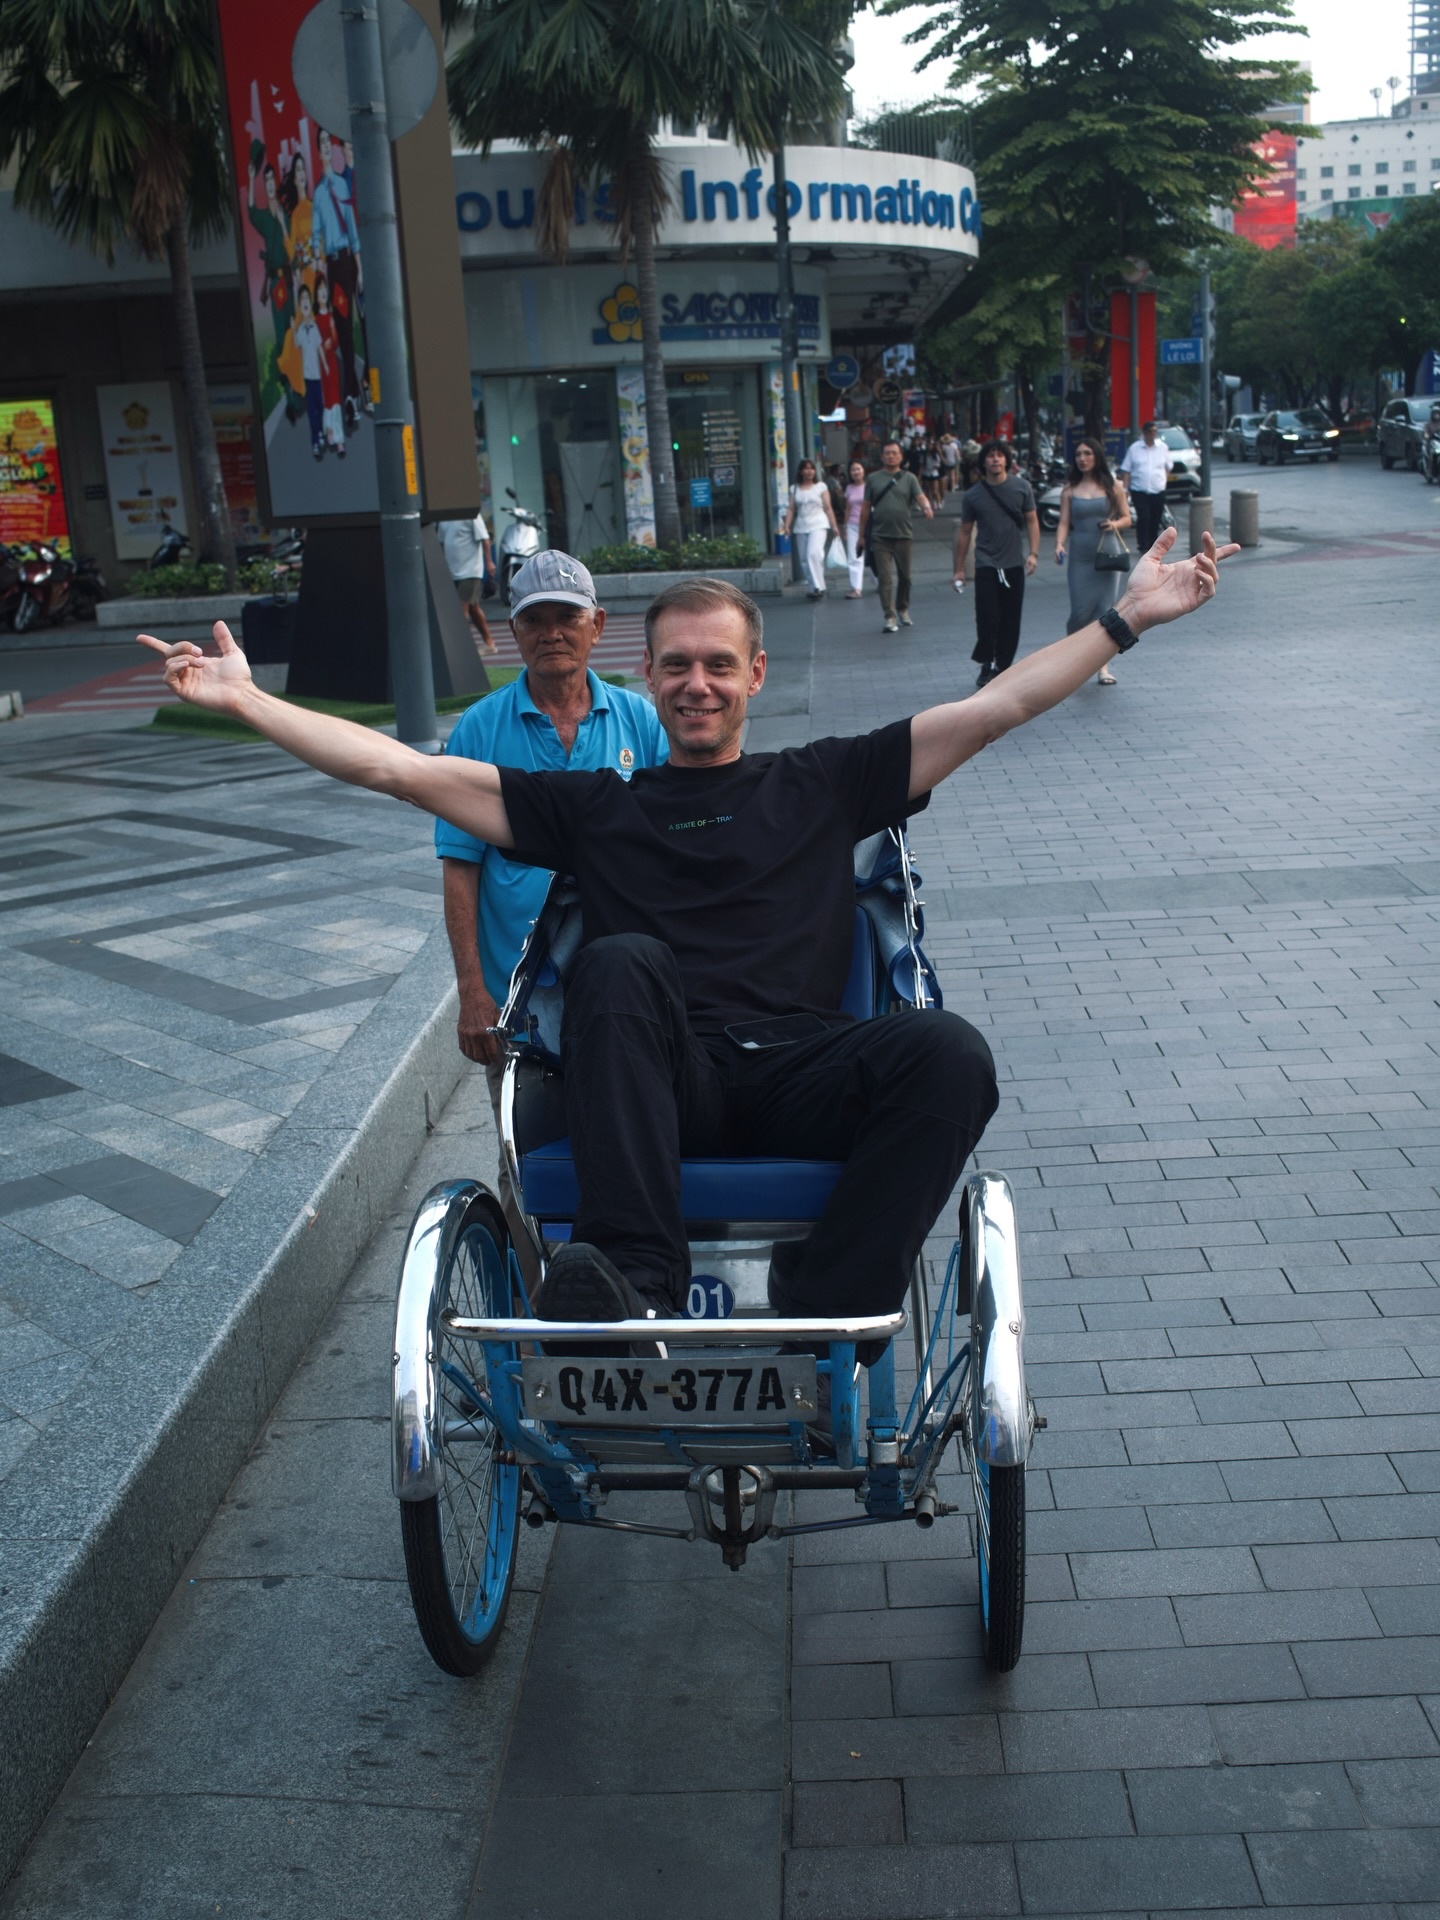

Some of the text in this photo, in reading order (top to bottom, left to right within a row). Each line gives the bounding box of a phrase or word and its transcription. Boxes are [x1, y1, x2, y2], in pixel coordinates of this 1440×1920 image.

[680, 168, 955, 230] Information
[675, 821, 696, 830] STATE
[697, 819, 707, 827] OF
[687, 1283, 726, 1319] 01
[558, 1366, 787, 1416] Q4X-377A
